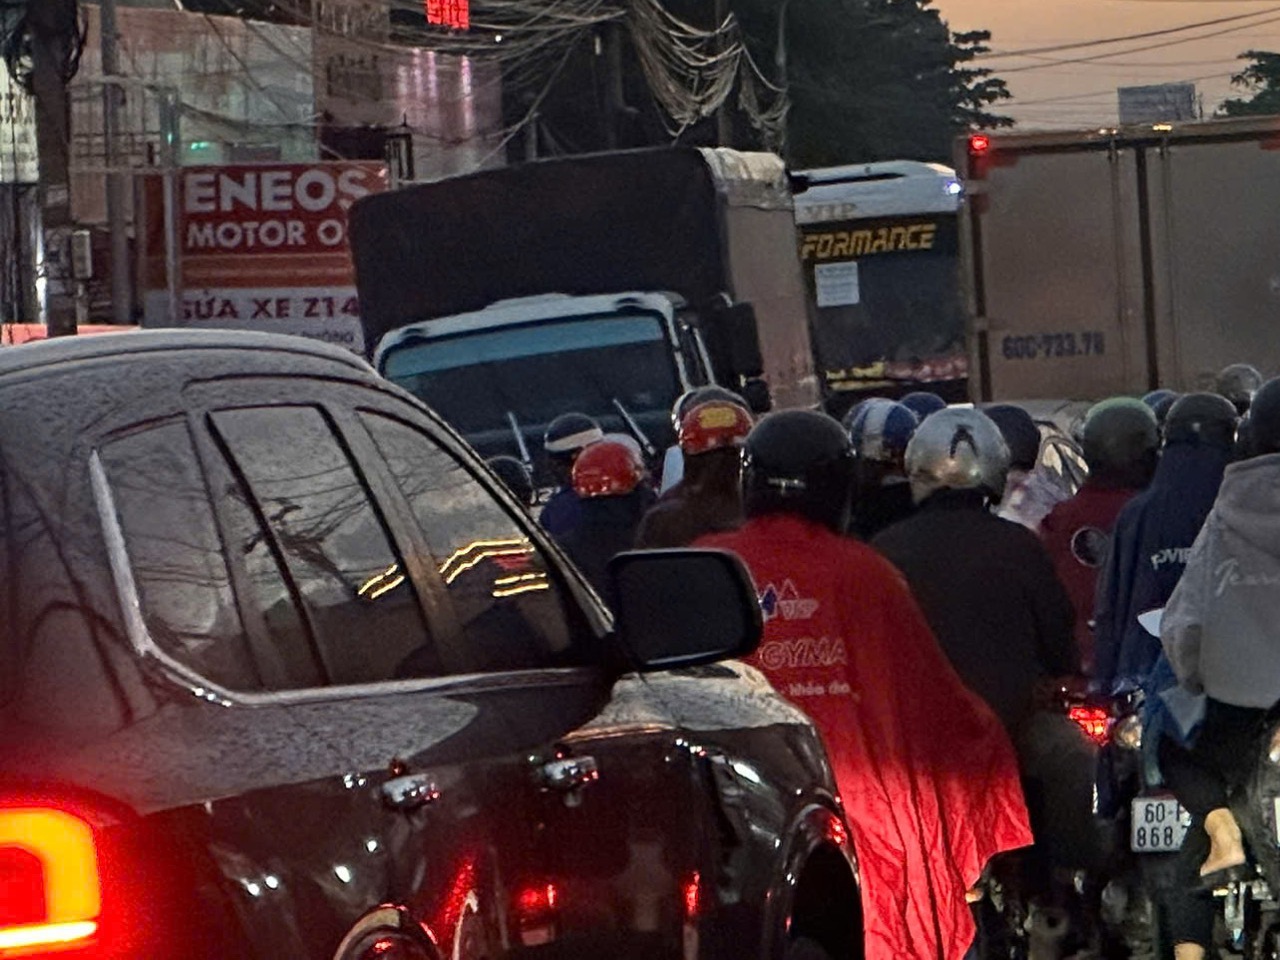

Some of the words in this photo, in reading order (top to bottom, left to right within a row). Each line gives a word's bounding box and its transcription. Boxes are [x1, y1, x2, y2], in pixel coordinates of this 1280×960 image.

[185, 169, 371, 213] ENEOS
[187, 220, 307, 248] MOTOR
[801, 223, 937, 259] FORMANCE
[253, 298, 290, 319] XE
